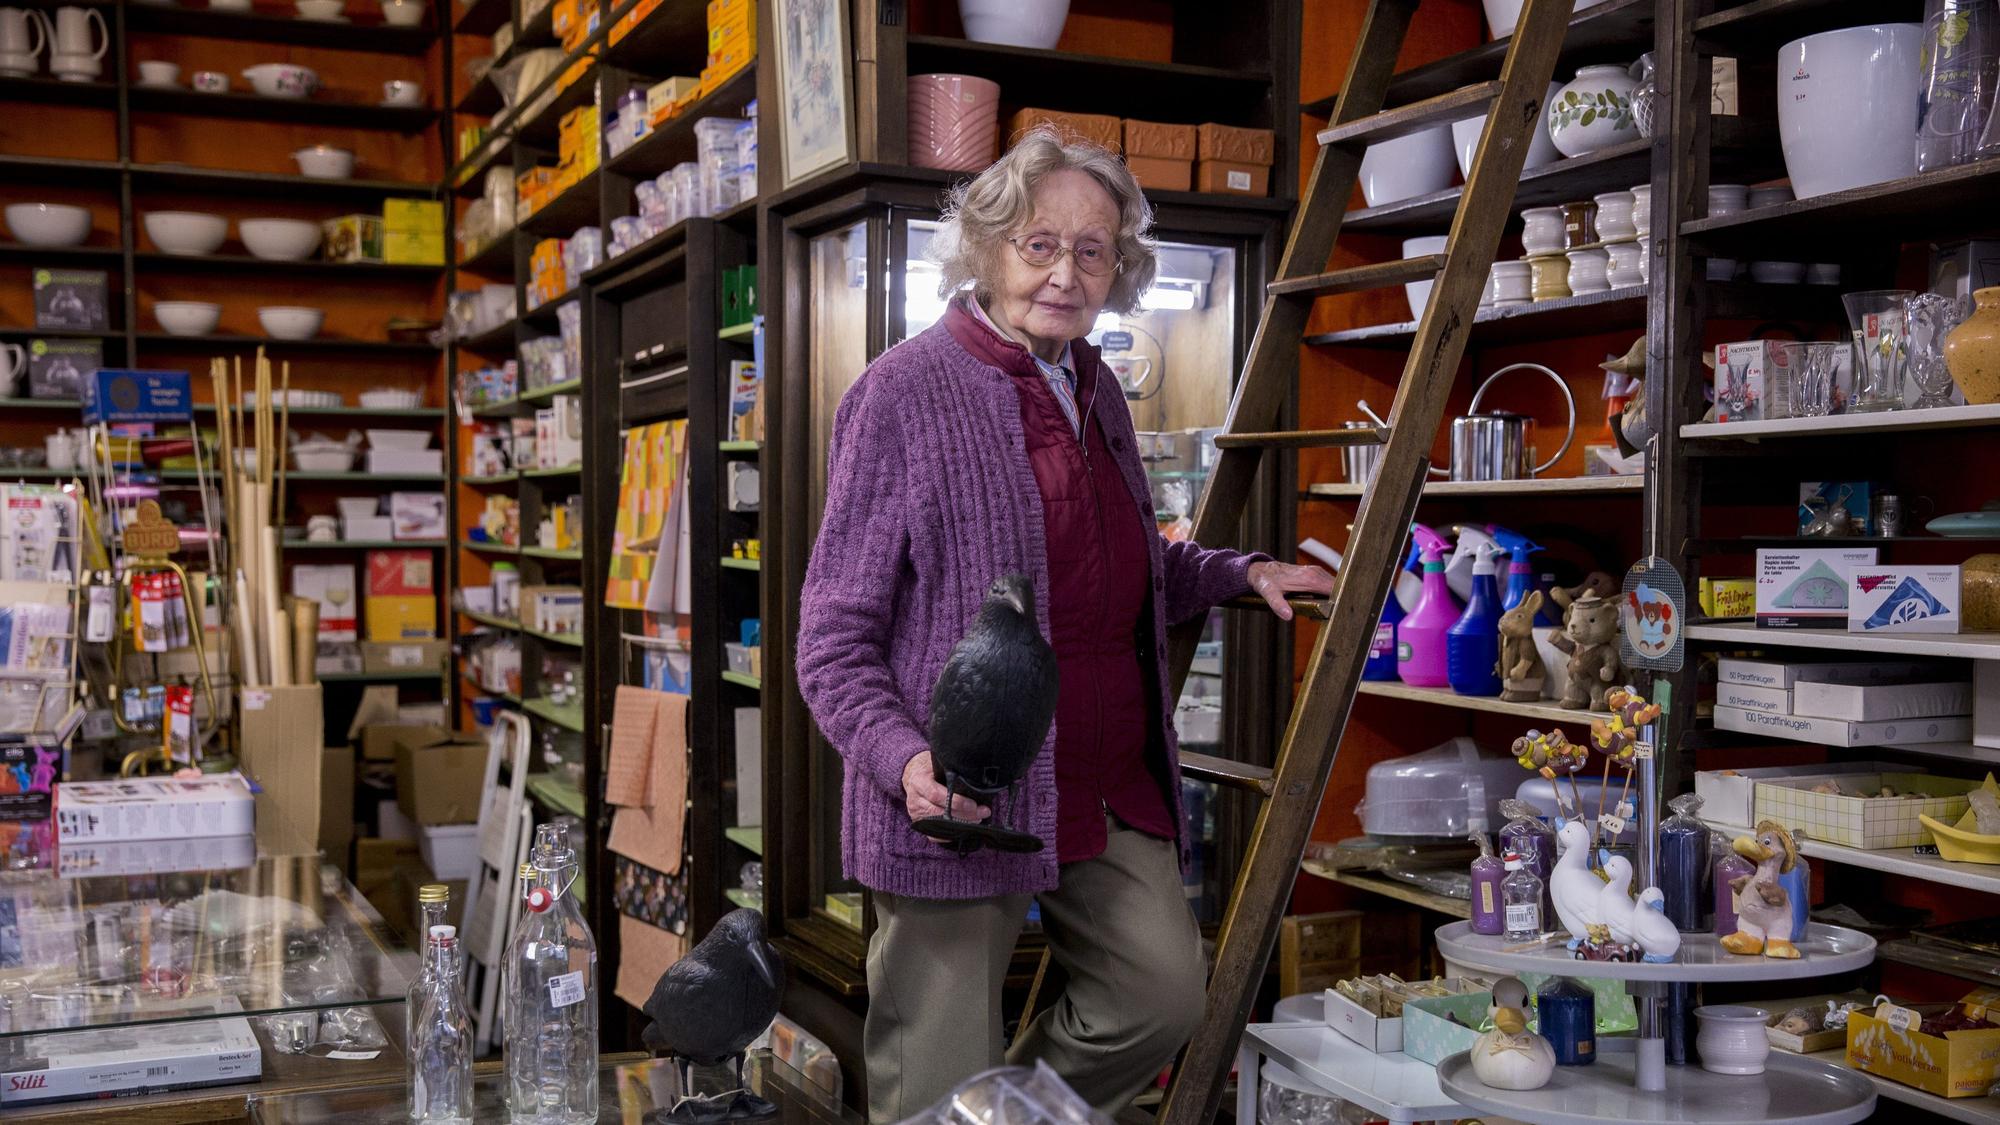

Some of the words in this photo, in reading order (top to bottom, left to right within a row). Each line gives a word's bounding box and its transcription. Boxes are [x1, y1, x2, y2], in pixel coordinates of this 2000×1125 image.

[126, 533, 175, 548] BURG
[1737, 672, 1776, 684] Paraffinkugeln
[1737, 697, 1778, 710] Paraffinkugeln
[1745, 712, 1756, 722] 100
[1757, 713, 1812, 731] Paraffinkugeln
[8, 1074, 48, 1092] Silit
